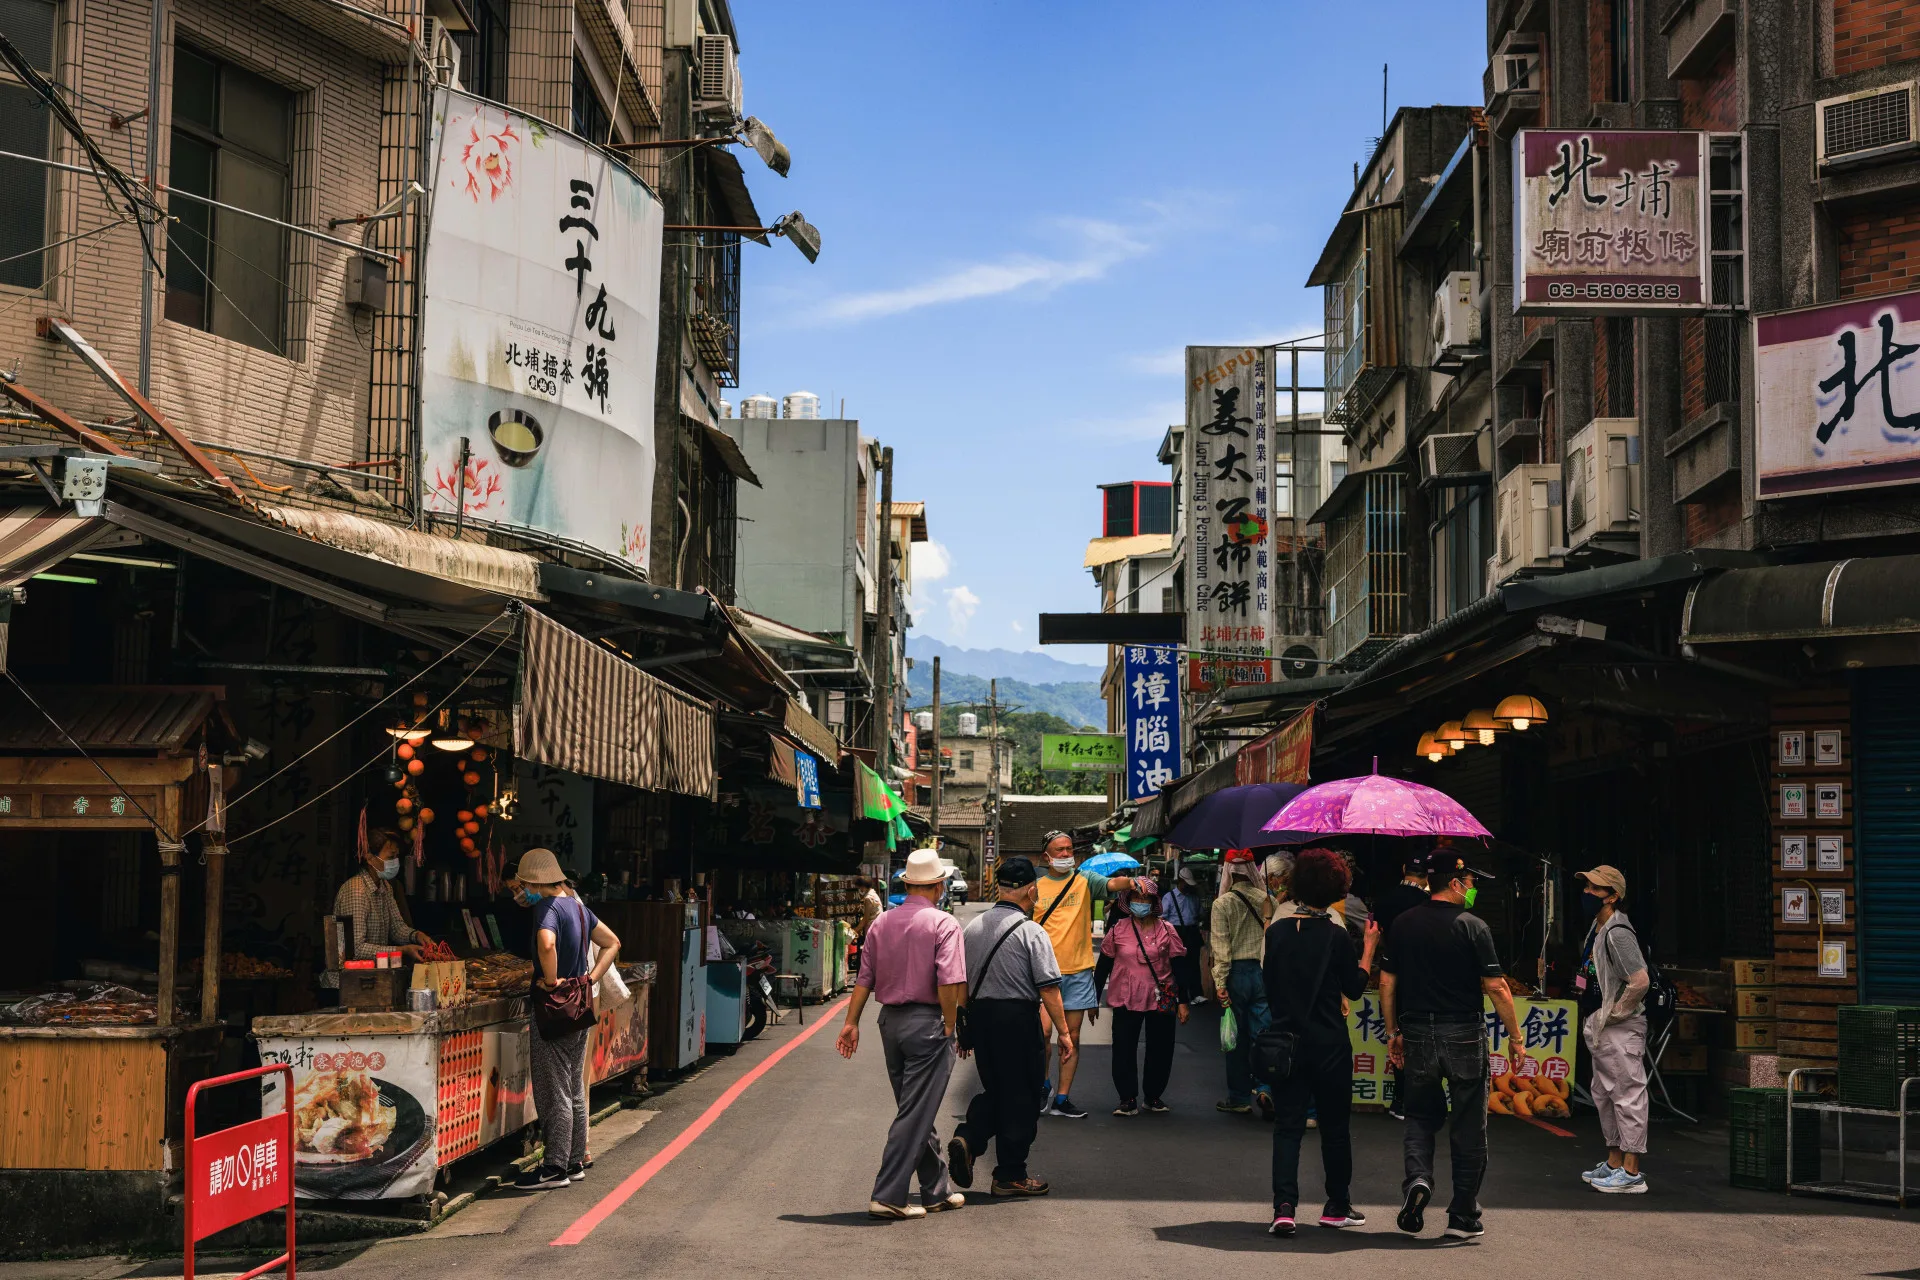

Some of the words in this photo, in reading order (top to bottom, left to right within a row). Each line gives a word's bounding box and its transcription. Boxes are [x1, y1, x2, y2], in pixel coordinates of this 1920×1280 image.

[1548, 135, 1677, 219] 北埔
[1536, 226, 1695, 262] 廟前粄條
[558, 178, 616, 415] 三十九號
[1548, 282, 1681, 300] 03-5803383
[505, 342, 574, 385] 北埔擂茶
[1191, 349, 1256, 393] PEIPU
[1816, 313, 1920, 445] 北
[1196, 441, 1211, 467] Lord
[1193, 472, 1211, 512] Jiang's
[1200, 387, 1254, 617] 姜太公柿餅
[1196, 517, 1211, 579] Persimmon
[1196, 584, 1212, 612] Cake
[1200, 625, 1265, 642] 北埔石柿
[1132, 671, 1173, 795] 樟腦油
[315, 1052, 385, 1071] 客家泡菜
[251, 1171, 278, 1191] 謝謝合作
